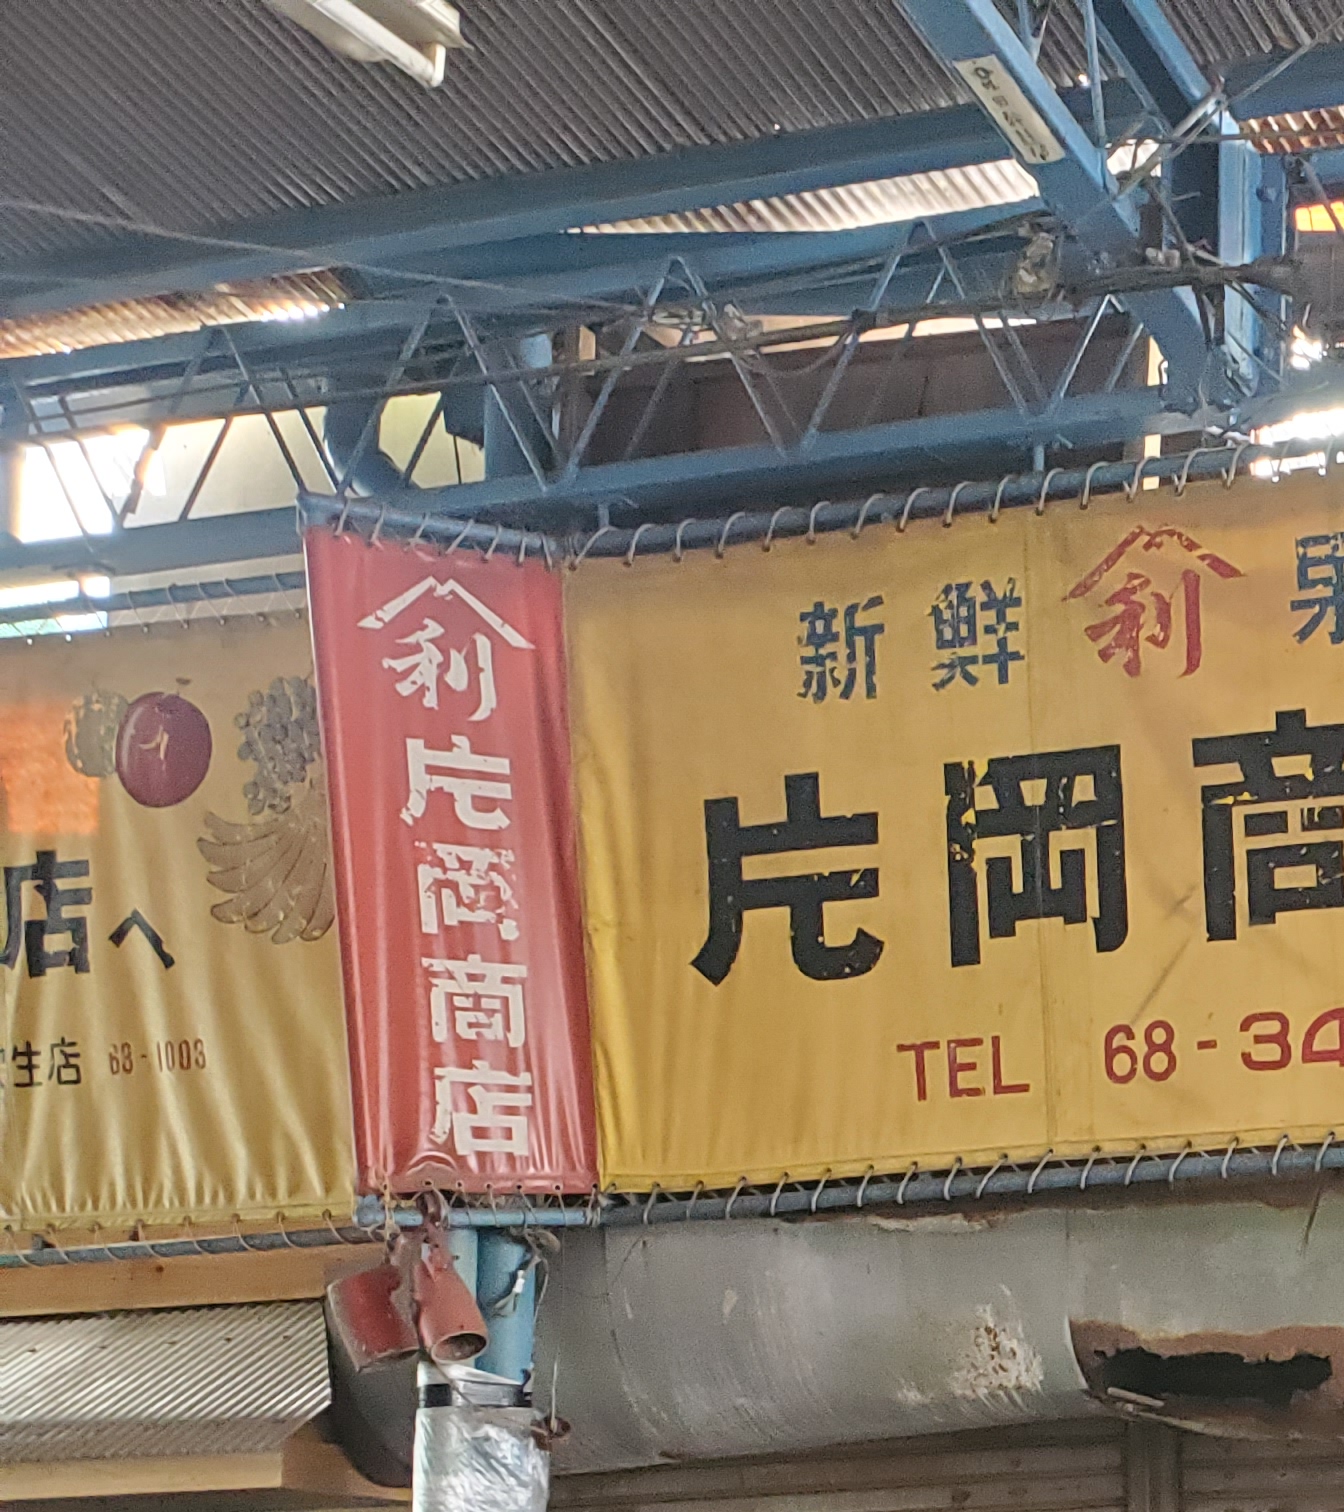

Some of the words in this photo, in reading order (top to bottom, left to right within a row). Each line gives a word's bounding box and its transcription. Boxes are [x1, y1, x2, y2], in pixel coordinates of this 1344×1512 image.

[797, 577, 1024, 703] 新鮮
[0, 1036, 82, 1088] 生店
[896, 1033, 1032, 1102] TEL
